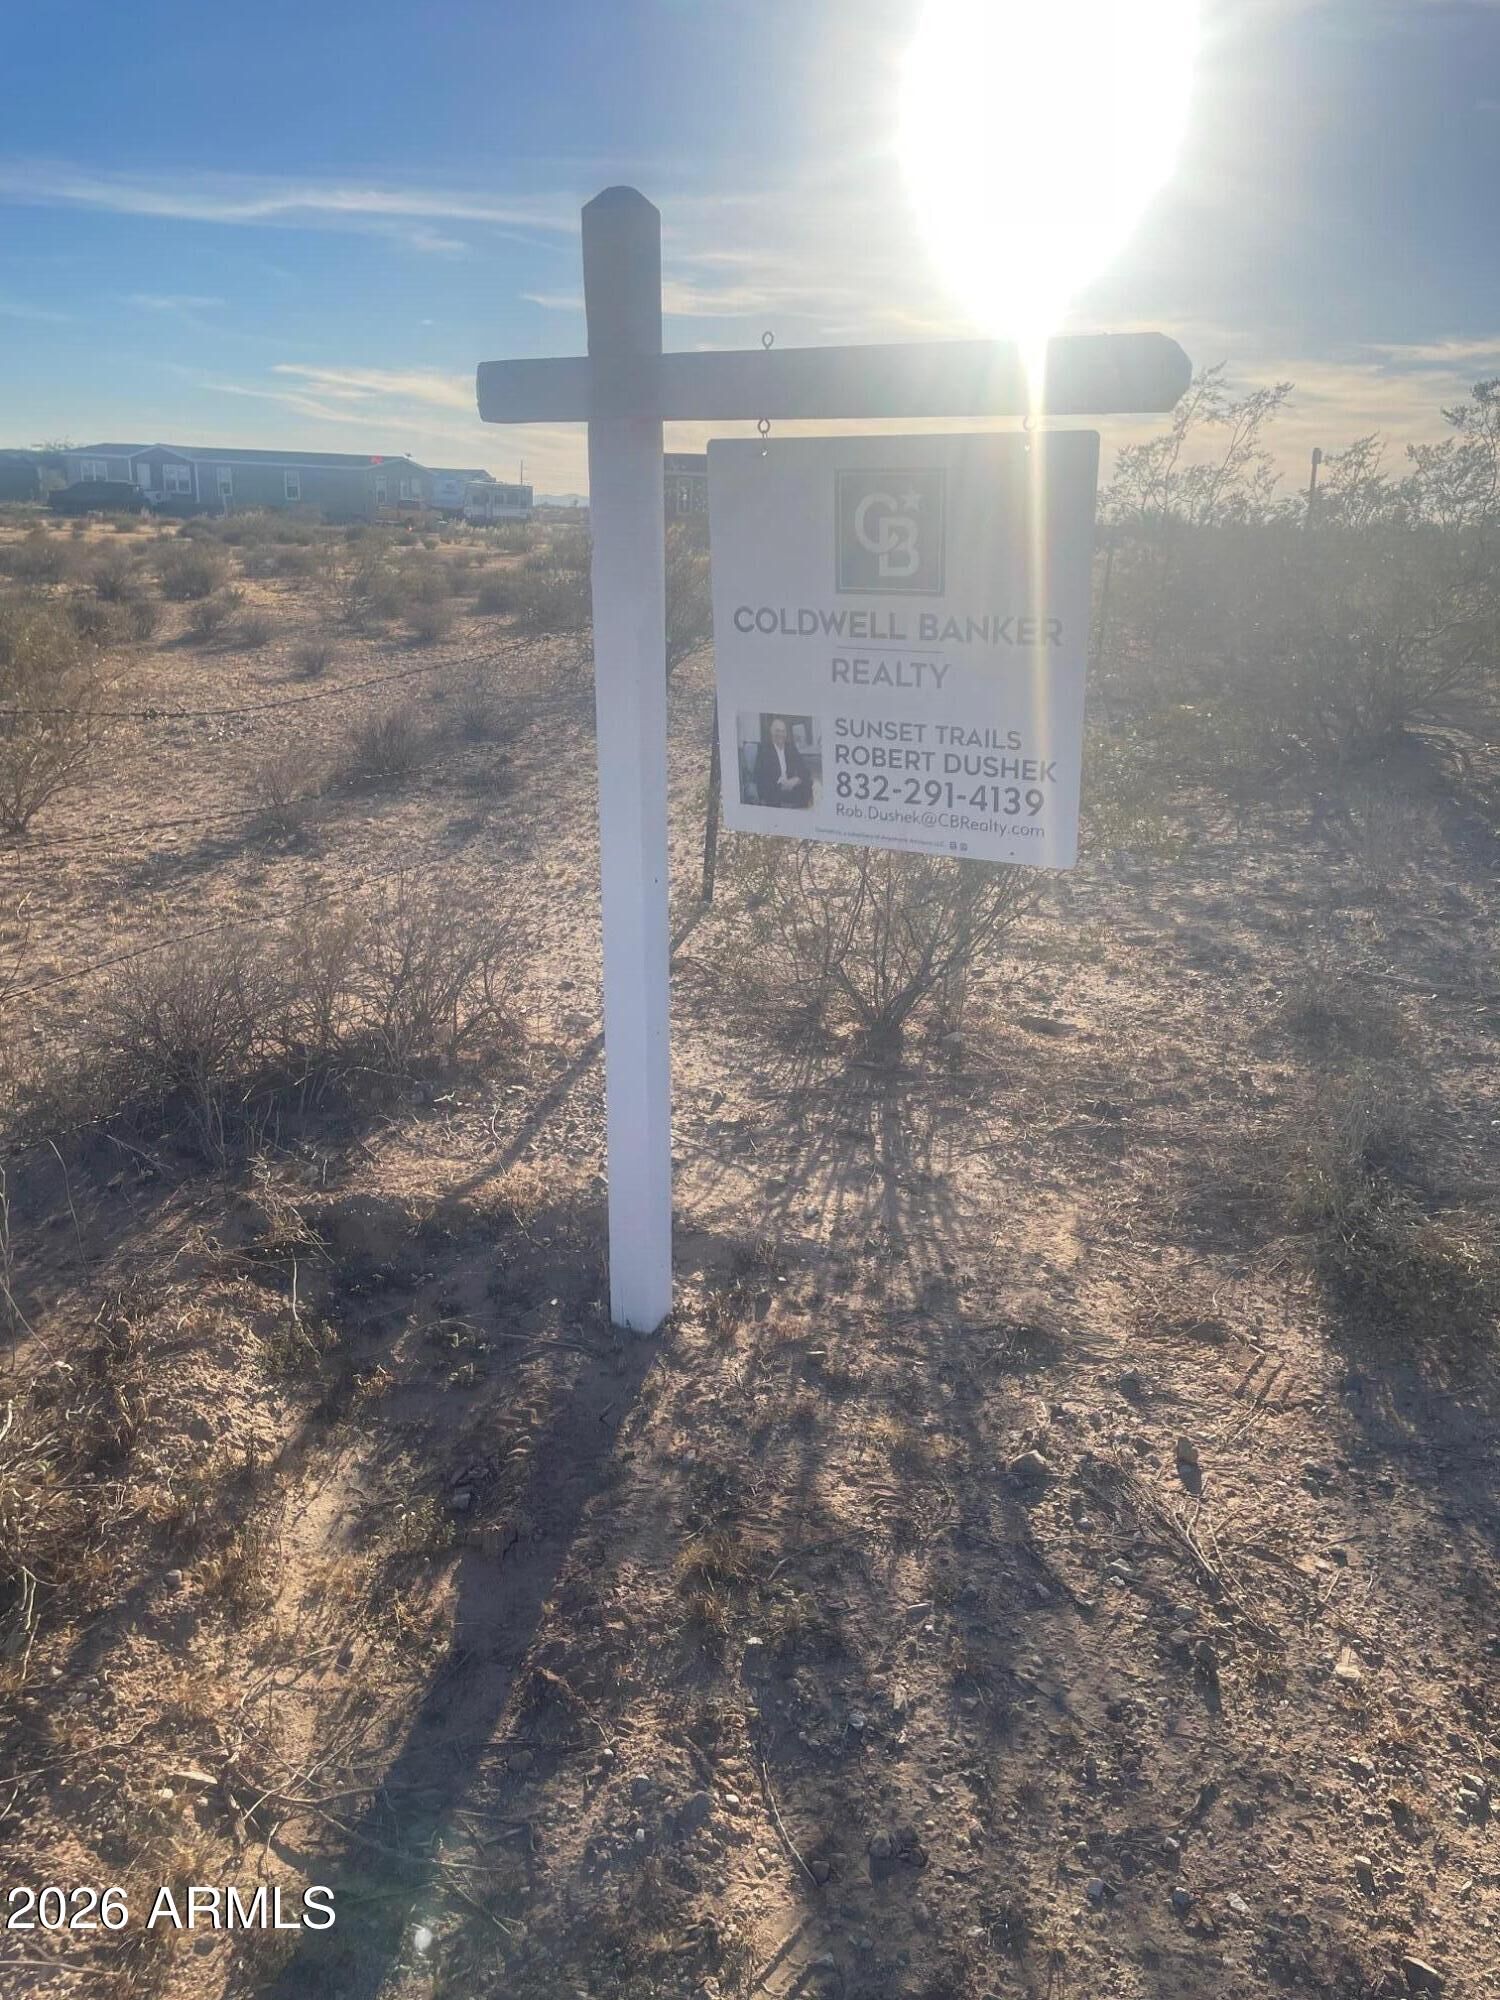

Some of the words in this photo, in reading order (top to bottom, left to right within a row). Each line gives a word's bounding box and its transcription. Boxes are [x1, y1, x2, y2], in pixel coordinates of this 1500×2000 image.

[733, 605, 907, 641] COLDWELL
[918, 612, 1063, 648] BANKER
[831, 657, 951, 689] REALTY
[834, 717, 927, 743] SUNSET
[935, 724, 1022, 750] TRAILS
[835, 743, 936, 772] ROBERT
[943, 752, 1058, 784] DUSHEK
[836, 770, 1045, 817] 832-291-4139
[835, 802, 1046, 838] Rob.Dushek@CBRealty.com
